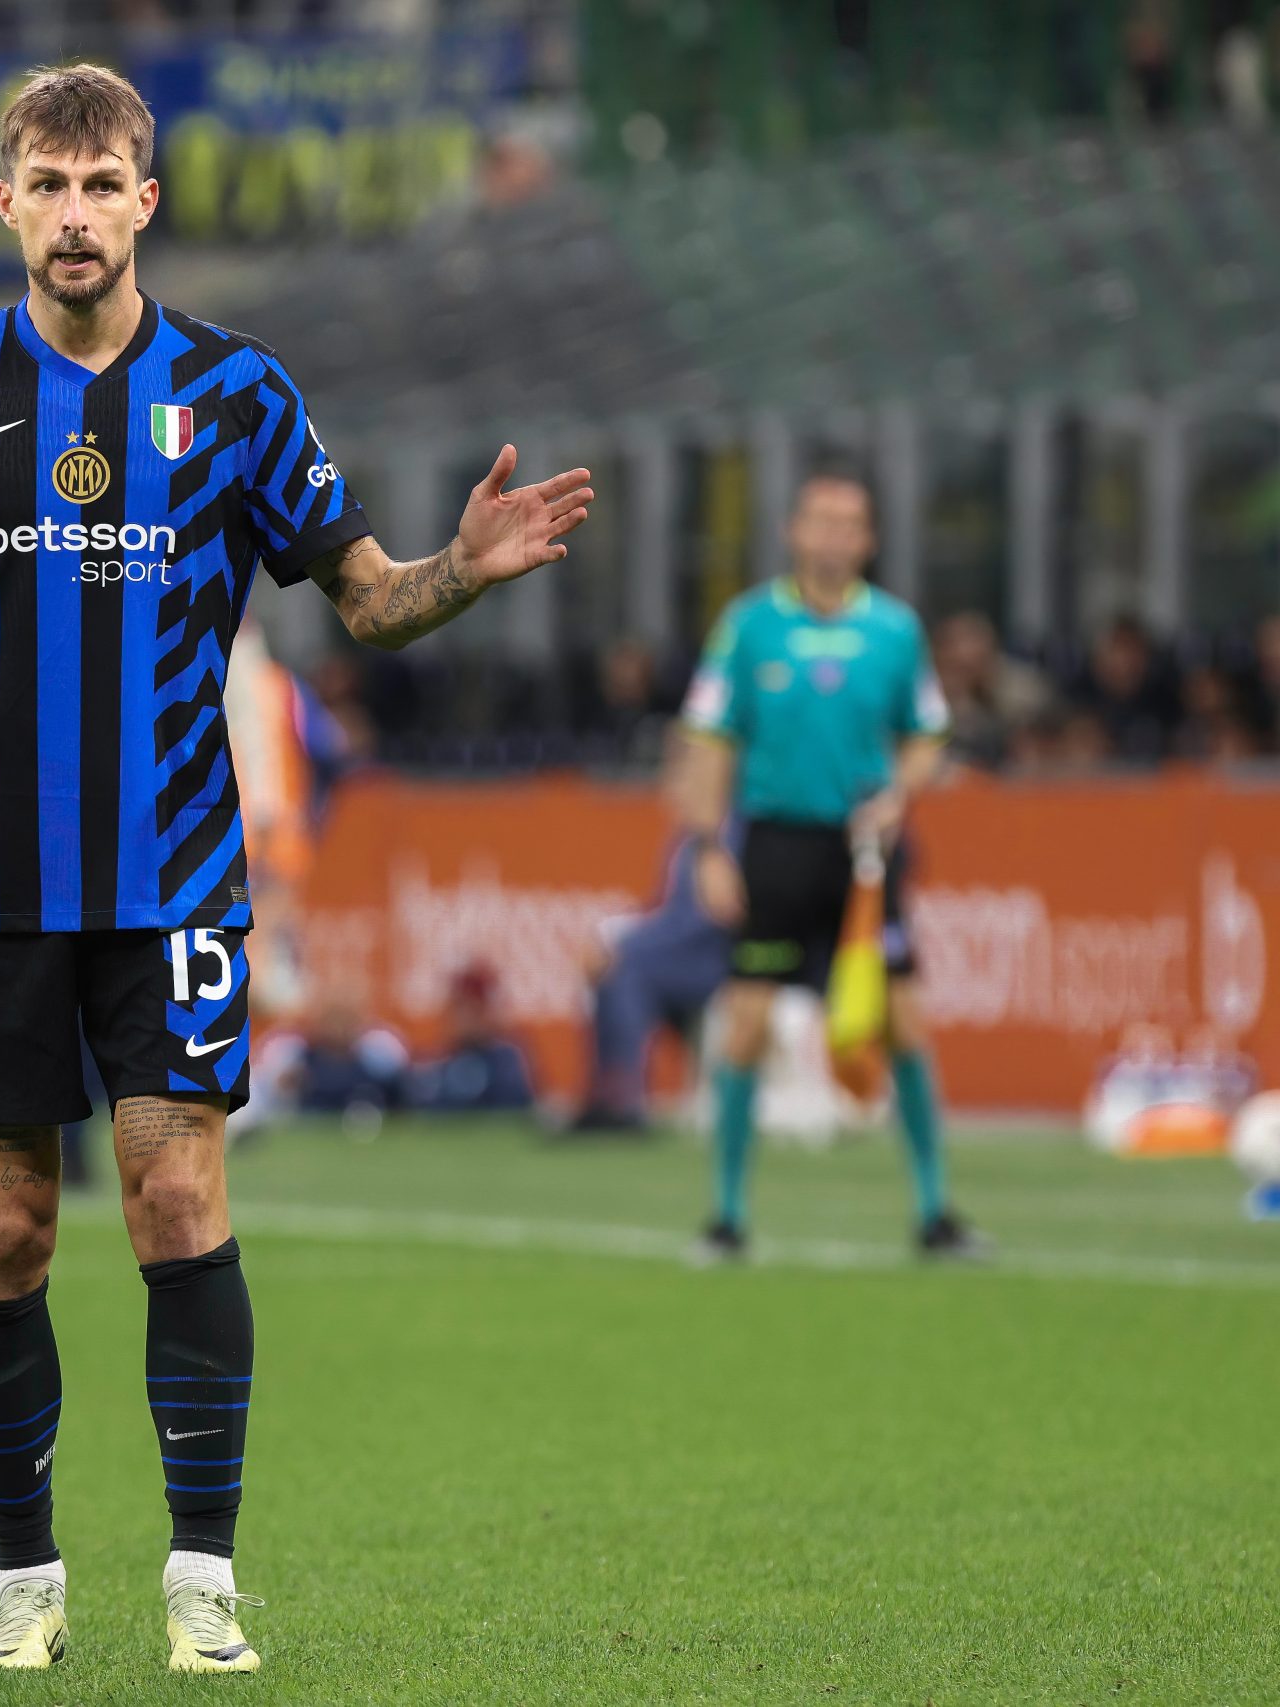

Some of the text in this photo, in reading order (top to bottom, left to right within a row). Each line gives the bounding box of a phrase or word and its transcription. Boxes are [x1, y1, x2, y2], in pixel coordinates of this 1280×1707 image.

[307, 462, 343, 488] Ga
[71, 558, 172, 588] .sport
[170, 928, 232, 1001] 15
[1, 1166, 18, 1190] by
[24, 1167, 48, 1189] day
